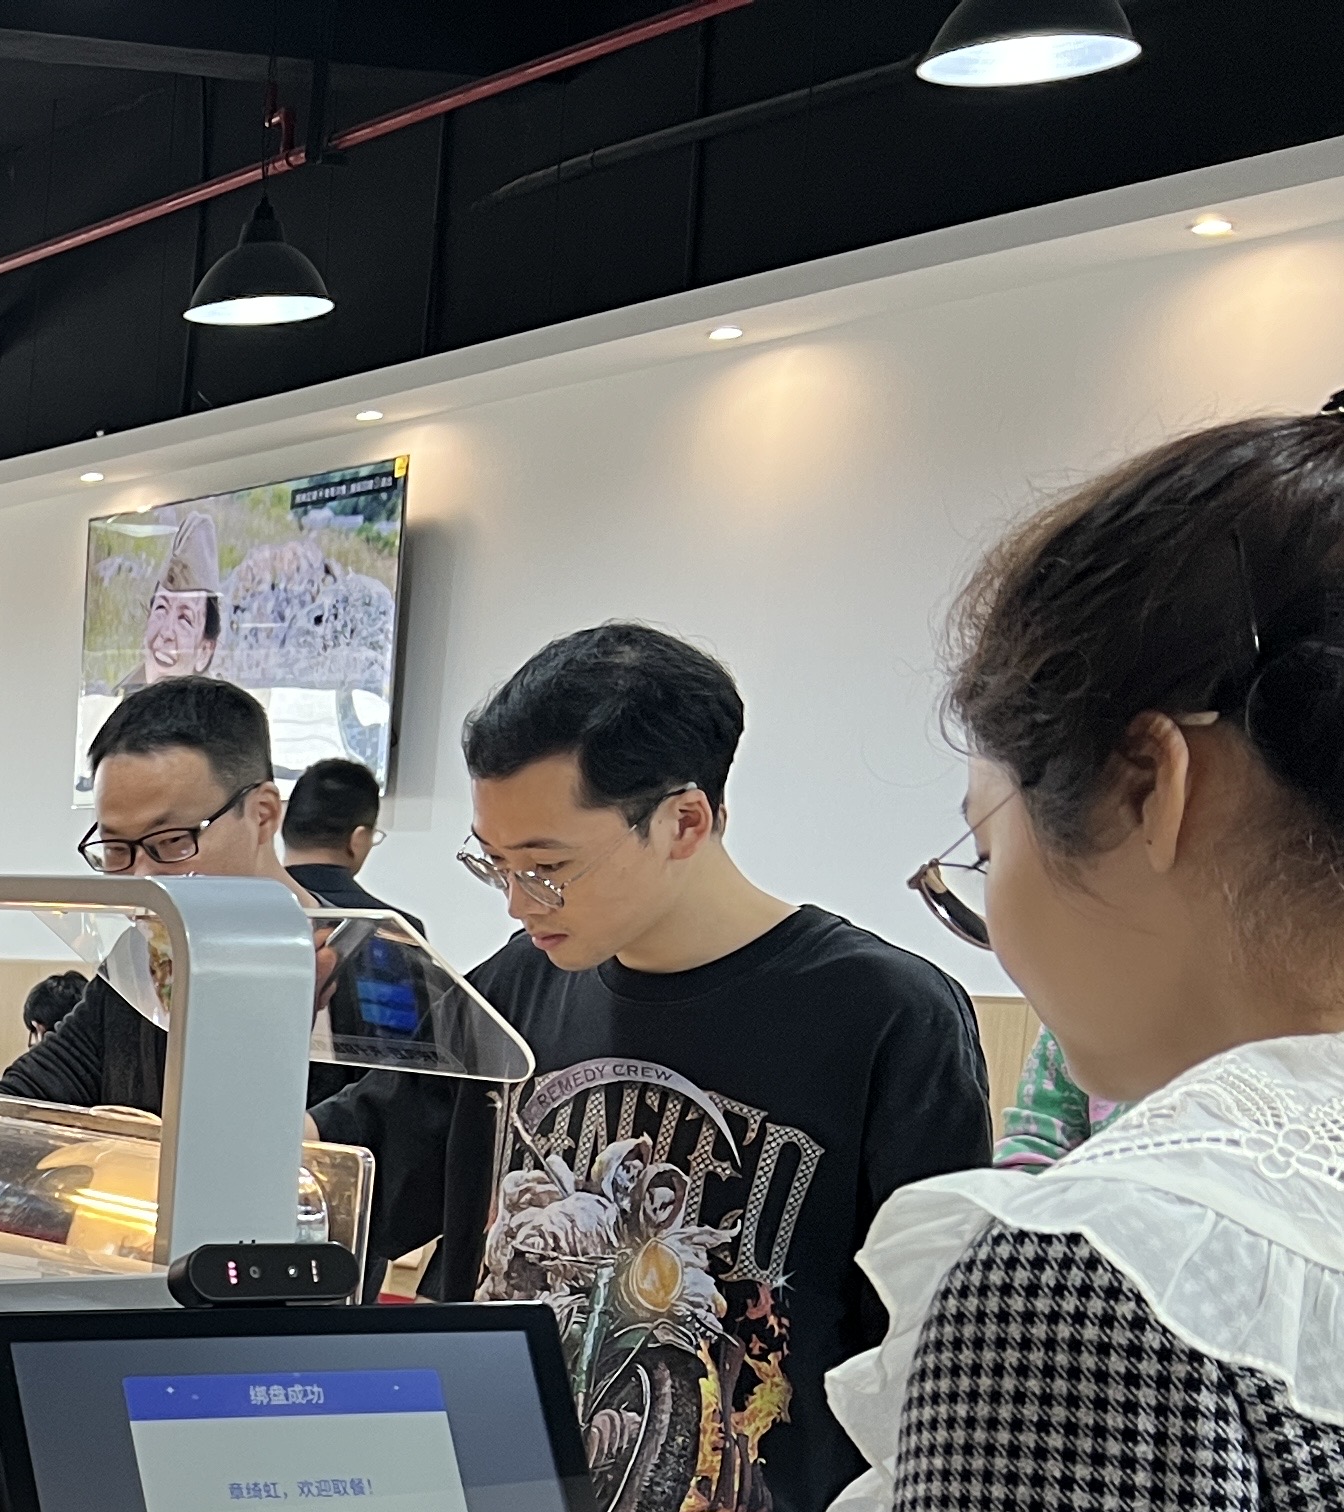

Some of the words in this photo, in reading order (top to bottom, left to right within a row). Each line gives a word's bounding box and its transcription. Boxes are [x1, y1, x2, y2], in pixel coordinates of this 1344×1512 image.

[537, 1065, 607, 1107] REMEDY
[613, 1064, 673, 1081] CREW
[249, 1384, 325, 1405] 绑盘成功
